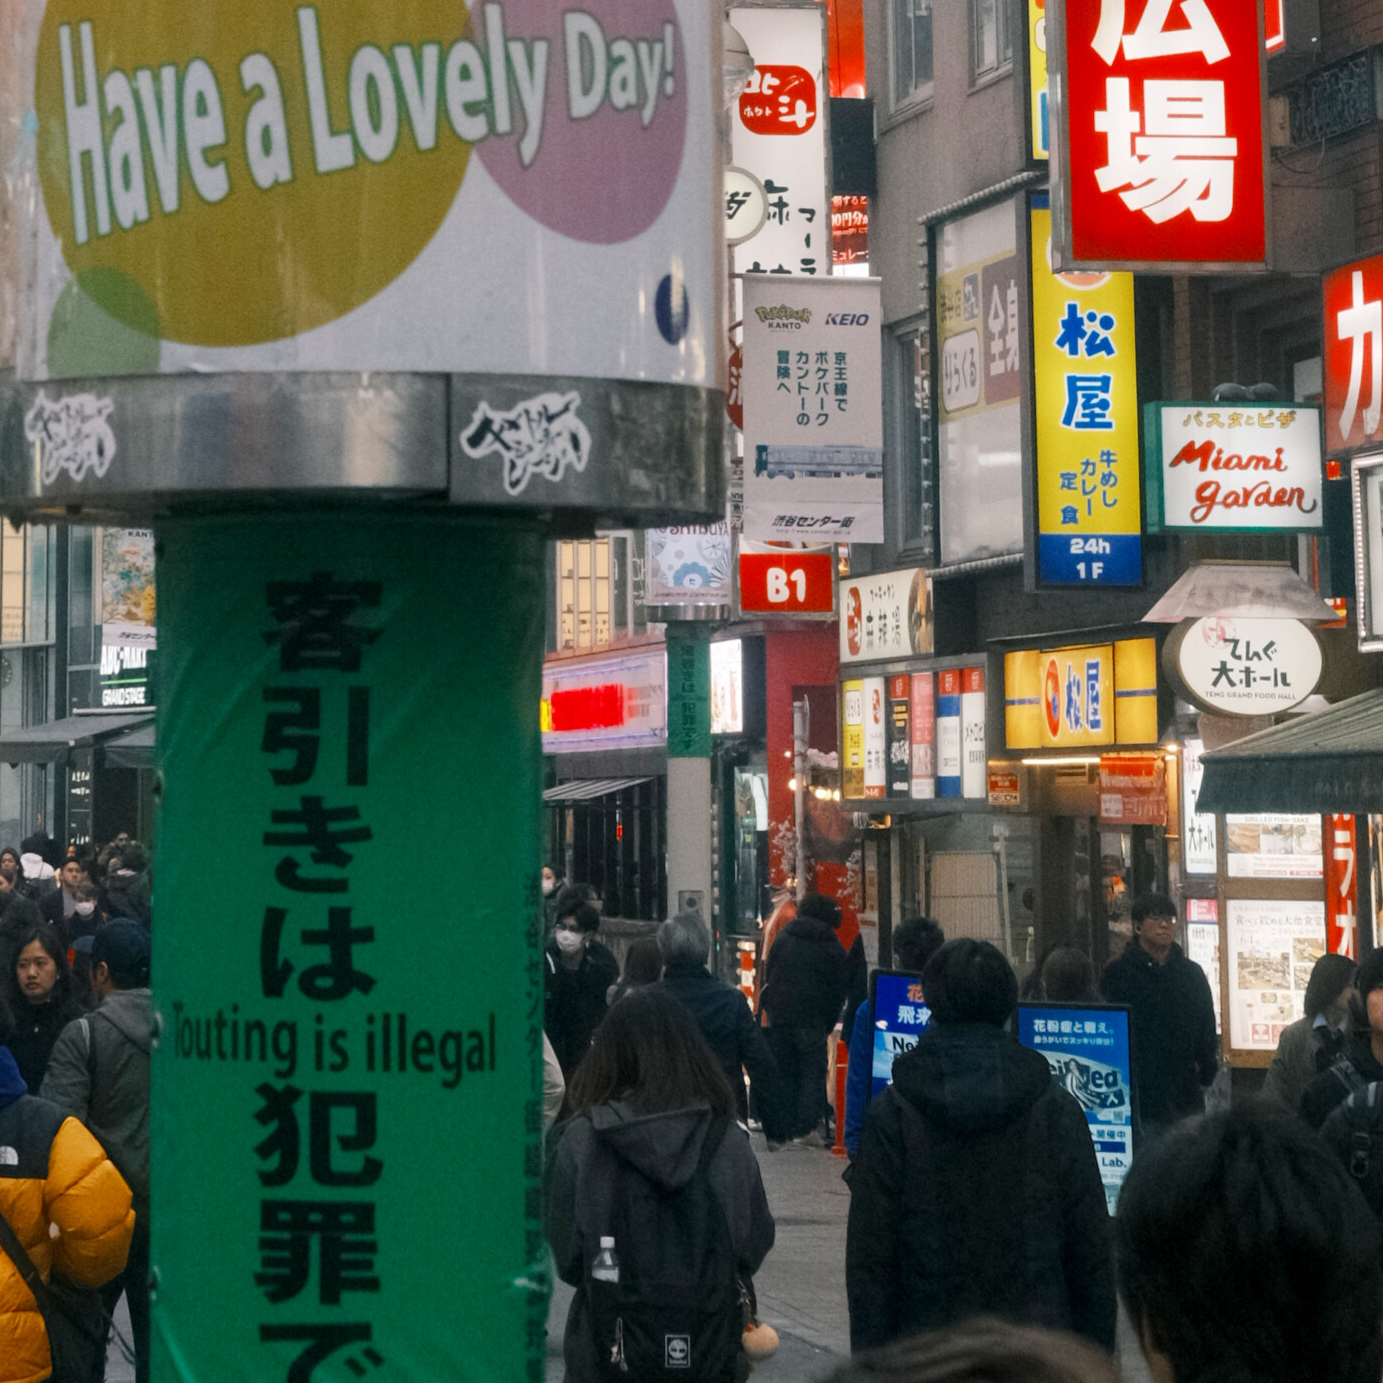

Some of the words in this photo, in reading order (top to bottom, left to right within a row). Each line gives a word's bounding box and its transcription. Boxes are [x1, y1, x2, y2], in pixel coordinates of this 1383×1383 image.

[59, 19, 231, 245] Have
[238, 51, 297, 192] a
[561, 11, 676, 128] Day!
[768, 321, 802, 331] KANTO
[824, 312, 870, 327] KEIO
[834, 350, 848, 412] 京王線で
[1054, 302, 1119, 432] 松屋
[796, 350, 811, 427] カントーの
[815, 350, 830, 427] ポケパーク
[1183, 409, 1297, 430] パスタとピザ
[1169, 439, 1289, 473] Miami
[1080, 457, 1098, 517] カレー
[1098, 449, 1119, 509] 牛めし
[1059, 471, 1080, 526] 定食
[771, 515, 855, 529] 渋谷センター街
[1070, 537, 1111, 556] 24h
[765, 566, 807, 604] B1
[1076, 562, 1105, 580] 1F
[1223, 637, 1279, 663] てんぐ
[1210, 666, 1292, 690] 大ホール
[1226, 691, 1252, 699] GRAND
[1254, 691, 1276, 700] FOOD
[172, 998, 300, 1078] Touting
[314, 1014, 351, 1074] is
[365, 1011, 498, 1091] illegal
